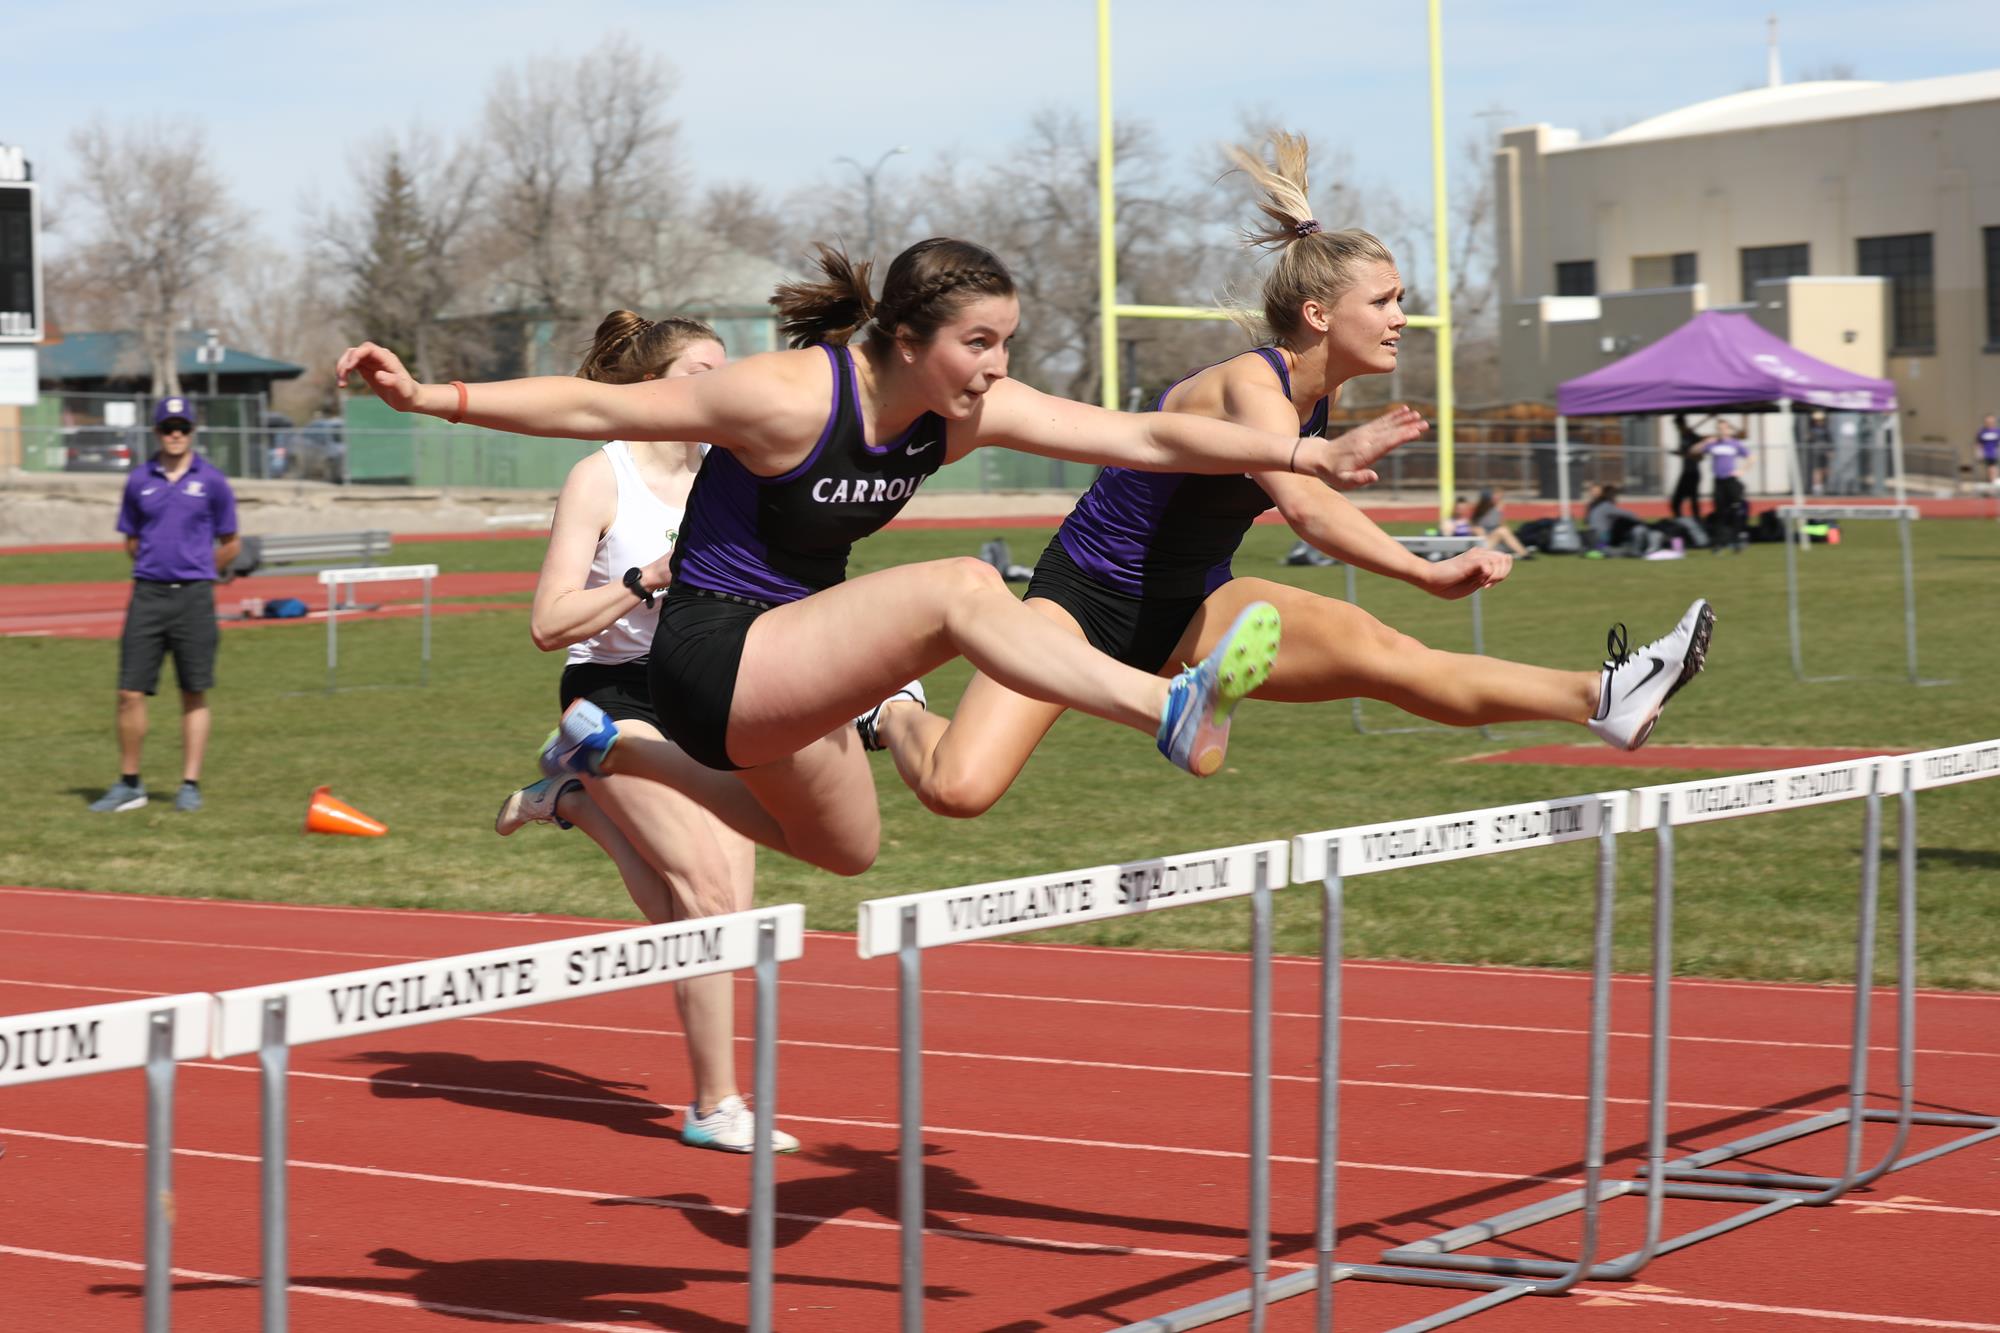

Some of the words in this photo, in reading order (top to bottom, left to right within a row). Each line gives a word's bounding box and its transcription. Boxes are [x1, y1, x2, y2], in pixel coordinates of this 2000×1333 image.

[1686, 779, 1776, 813] VIGILANTE
[1788, 768, 1858, 800] STADIUM
[1363, 820, 1476, 862] VIGILANTE
[1494, 805, 1583, 843] STADIUM
[946, 879, 1094, 929] VIGILANTE
[1118, 857, 1231, 904] STADIUM
[329, 958, 537, 1025] VIGILANTE
[567, 927, 725, 986] STADIUM
